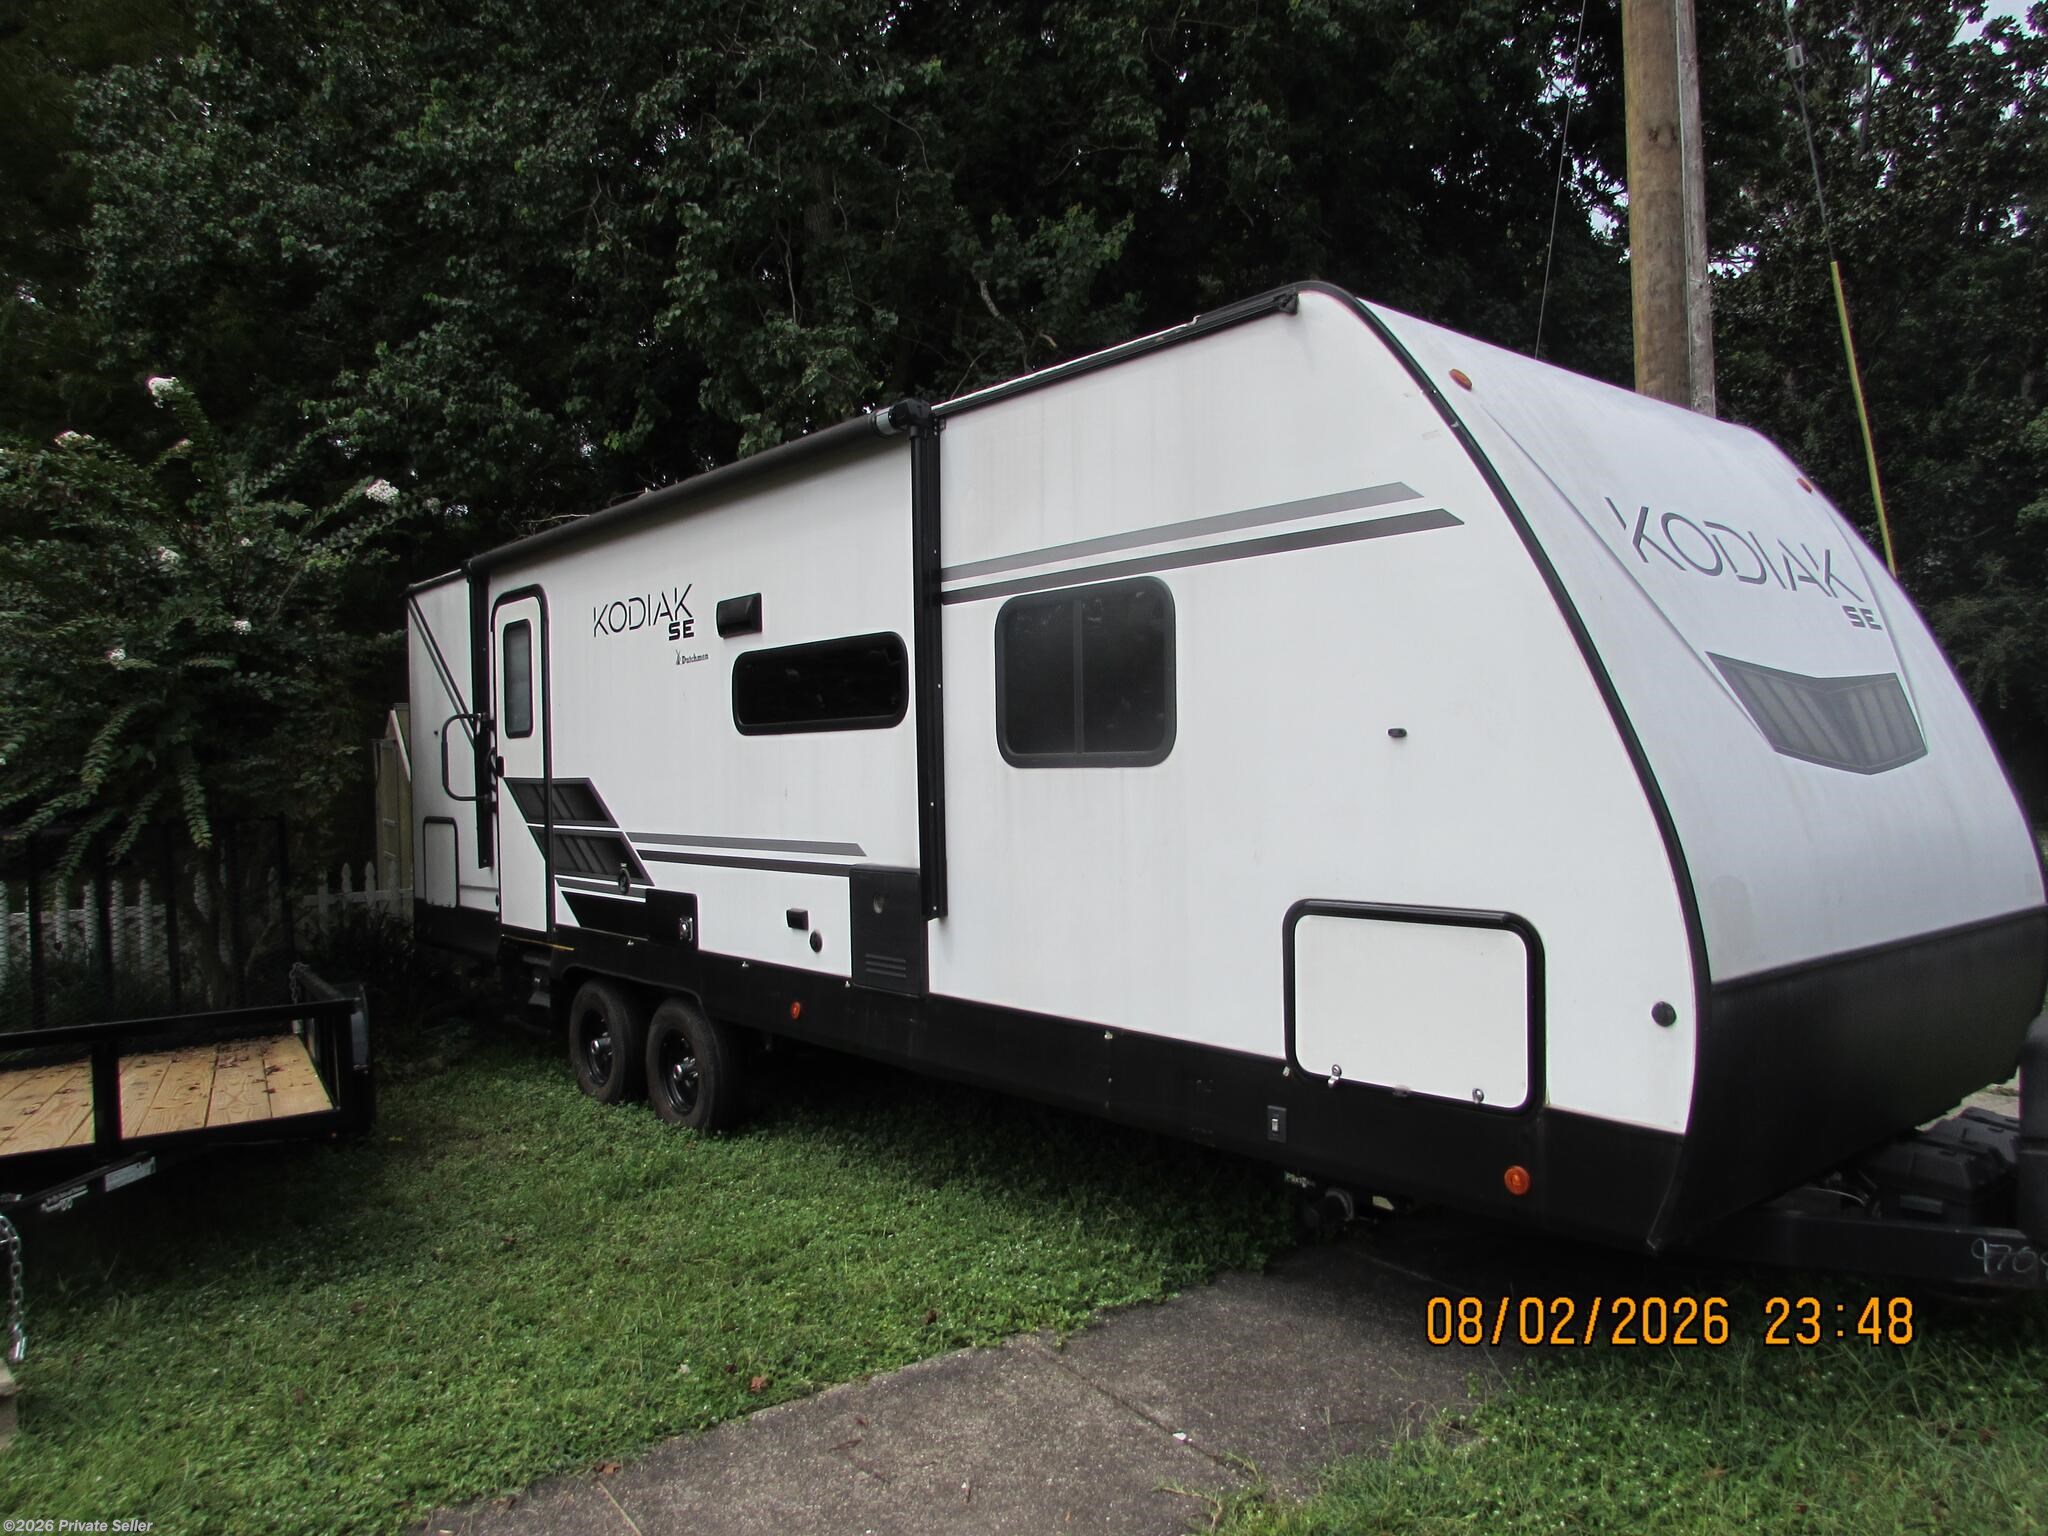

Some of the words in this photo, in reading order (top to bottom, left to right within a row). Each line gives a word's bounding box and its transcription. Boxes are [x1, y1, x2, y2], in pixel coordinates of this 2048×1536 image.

[1604, 496, 1865, 603] KODIAK
[593, 583, 693, 638] KODIAK
[668, 618, 694, 641] SE
[1842, 605, 1882, 631] SE
